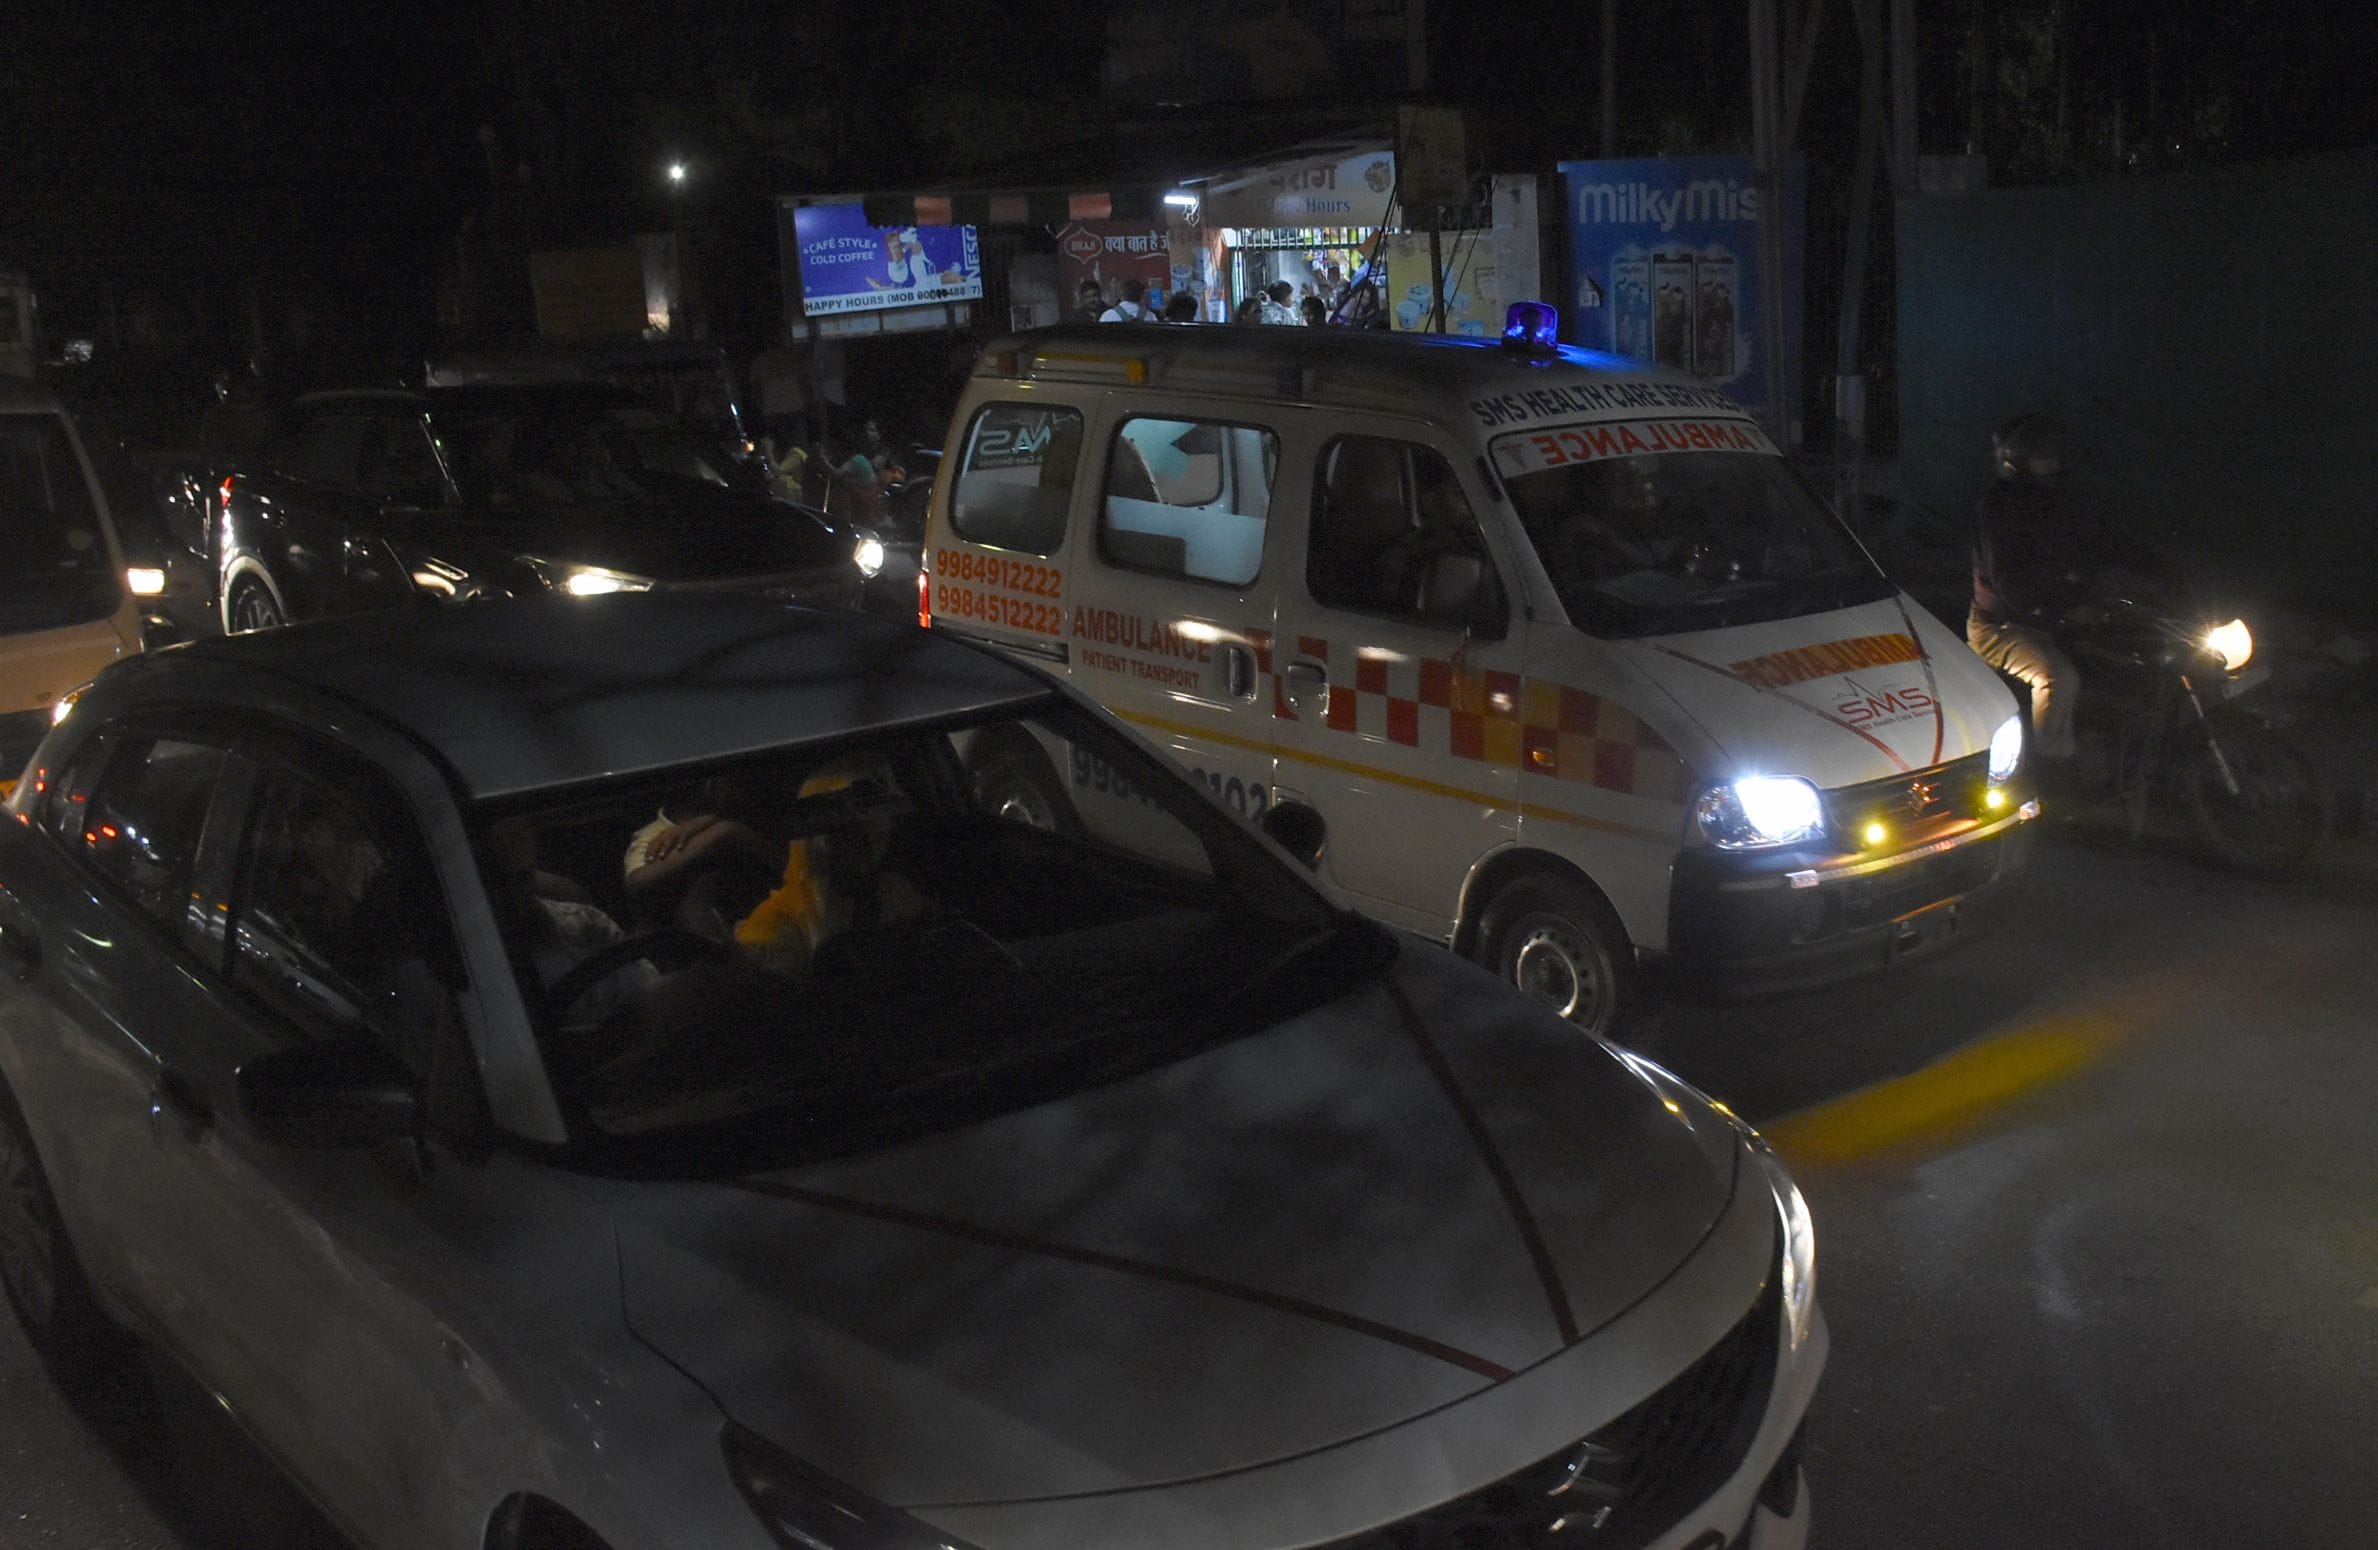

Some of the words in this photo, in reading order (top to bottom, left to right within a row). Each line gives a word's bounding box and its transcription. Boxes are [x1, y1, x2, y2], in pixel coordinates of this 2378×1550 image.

[1306, 197, 1351, 213] Hours
[808, 237, 836, 254] CAFÉ
[838, 237, 871, 249] STYLE
[810, 254, 836, 266] COLD
[839, 251, 874, 263] COFFEE
[1104, 236, 1125, 252] क्या
[1127, 236, 1148, 252] बात
[805, 300, 842, 312] HAPPY
[846, 295, 884, 308] HOURS
[887, 291, 914, 304] (MOB
[1472, 397, 1527, 427] SMS
[1518, 384, 1612, 418] HEALTH
[1602, 383, 1665, 408] CARE
[937, 547, 1061, 599] 9984912222
[938, 583, 1061, 636] 9984512222
[1072, 606, 1212, 664] AMBULANCE
[1082, 650, 1127, 673] PATIENT
[1129, 658, 1200, 690] TRANSPORT
[1838, 687, 1932, 724] SMS
